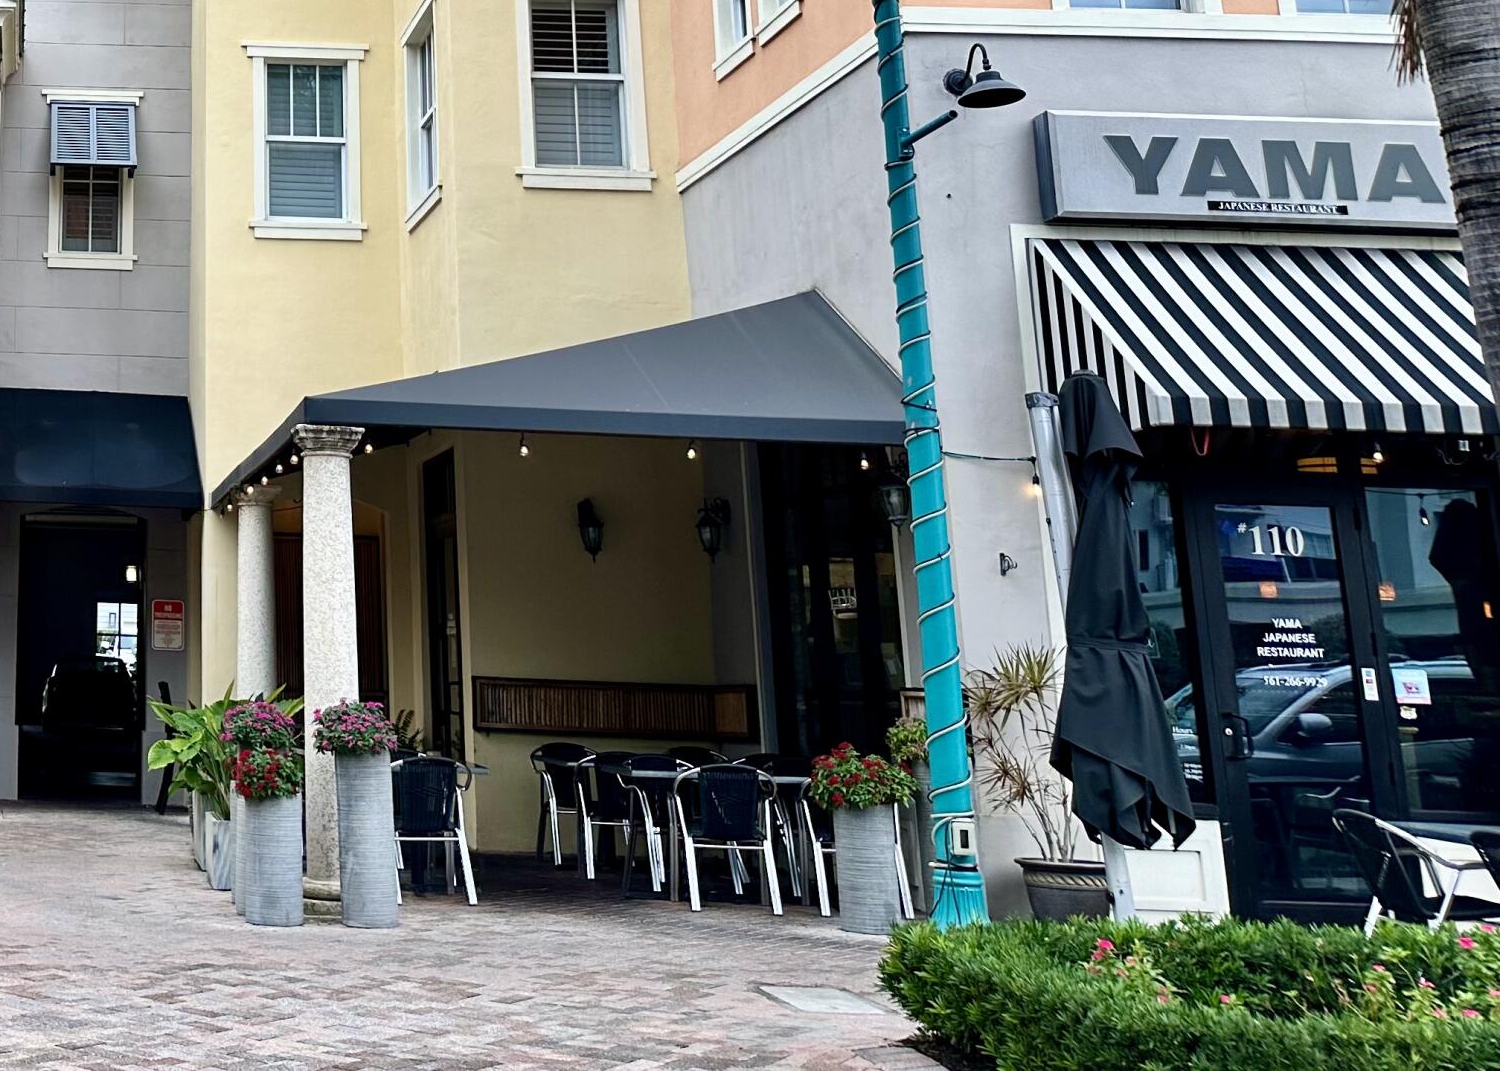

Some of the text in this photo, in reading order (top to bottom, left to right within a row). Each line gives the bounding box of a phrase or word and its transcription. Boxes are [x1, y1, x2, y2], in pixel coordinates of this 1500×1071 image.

[1102, 135, 1446, 204] YAMA
[1218, 201, 1338, 214] JAPANESE RESTAURANT
[1271, 618, 1303, 629] YAMA
[1262, 632, 1317, 644] JAPANESE
[1256, 646, 1325, 658] RESTAURANT
